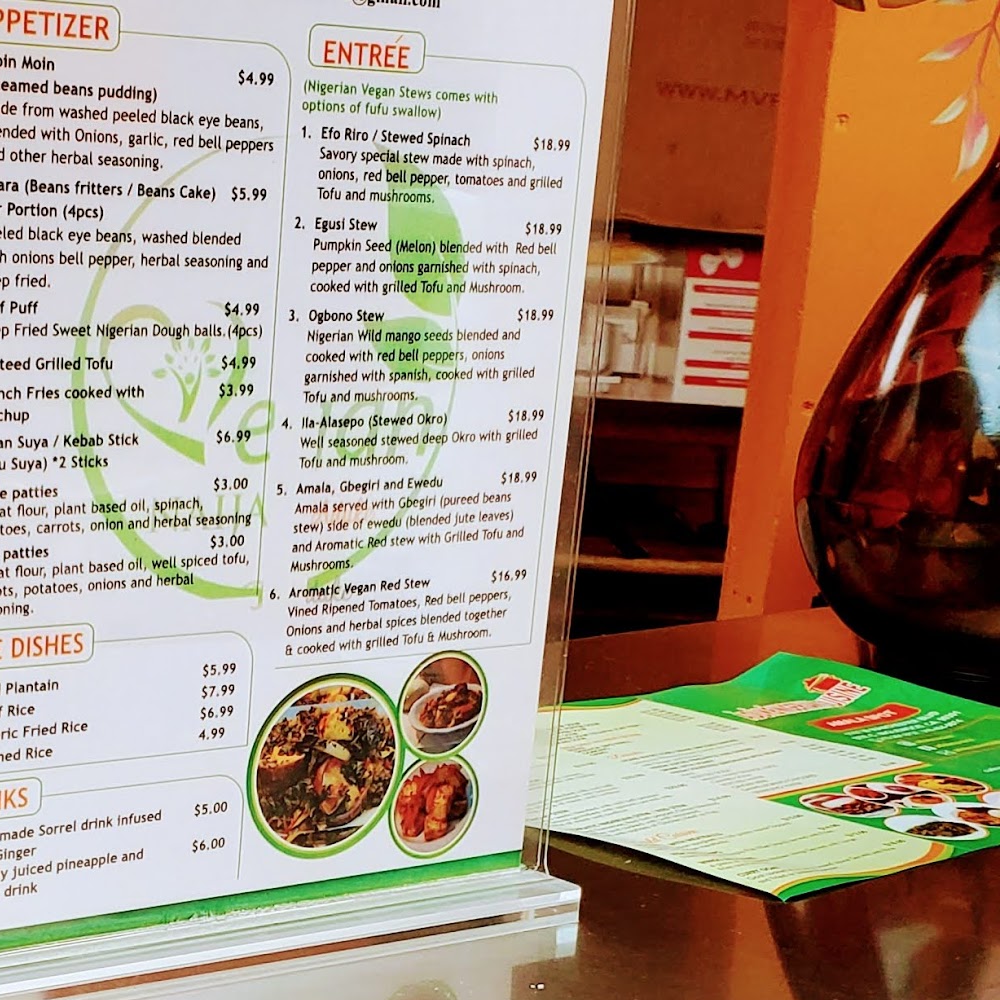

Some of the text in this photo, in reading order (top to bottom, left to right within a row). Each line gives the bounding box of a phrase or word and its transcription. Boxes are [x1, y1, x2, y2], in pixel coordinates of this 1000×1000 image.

[323, 34, 411, 70] ENTRÉE
[22, 55, 55, 71] Moin
[238, 70, 275, 86] $4.99
[53, 81, 94, 97] beans
[98, 86, 158, 104] pudding)
[304, 79, 498, 104] (Nigerian Vegan Stews comes with
[302, 100, 443, 121] options of fufu swallow)
[301, 126, 471, 148] 1. Efo Riro / Stewed Spinach
[533, 137, 571, 152] $18.99
[24, 179, 70, 196] (Beans
[74, 181, 123, 197] fritters
[127, 183, 133, 198] /
[137, 184, 175, 200] Beans
[179, 185, 217, 203] Cake)
[231, 187, 268, 203] $5.99
[7, 202, 58, 218] Portion
[62, 204, 104, 222] (4pcs)
[295, 217, 378, 233] 2. Egusi Stew
[525, 222, 562, 236] $18.99
[9, 300, 39, 315] Puff
[224, 302, 260, 317] $4.99
[289, 309, 385, 324] 3. Ogbono Stew
[517, 309, 554, 323] $18.99
[35, 356, 81, 371] Grilled
[85, 356, 113, 371] Tofu
[221, 355, 257, 370] $4.99
[26, 385, 60, 400] Fries
[64, 385, 112, 399] cooked
[116, 384, 145, 399] with
[219, 383, 254, 398] $3.99
[282, 412, 448, 430] 4. Ila-Alasepo (Stewed Okro)
[507, 409, 545, 423] $18.99
[17, 436, 49, 451] Suya
[52, 435, 59, 449] /
[63, 434, 104, 448] Kebab
[108, 433, 139, 447] Stick
[216, 430, 251, 444] $6.99
[11, 457, 48, 473] Suya)
[71, 455, 108, 469] Sticks
[213, 478, 249, 492] $3.00
[276, 476, 444, 496] 5. Amala, Gbegiri and Ewedu
[500, 471, 538, 486] $18.99
[12, 486, 58, 501] patties
[210, 535, 245, 550] $3.00
[3, 546, 49, 561] patties
[491, 569, 527, 584] $16.99
[269, 576, 431, 600] 6. Aromatic Vegan Red Stew
[11, 632, 84, 658] DISHES
[202, 662, 237, 678] $5.99
[5, 679, 60, 695] Plantain
[201, 684, 235, 700] $7.99
[7, 704, 35, 718] Rice
[200, 705, 234, 720] $6.99
[22, 723, 57, 738] Fried
[61, 720, 88, 735] Rice
[198, 727, 226, 741] 4.99
[25, 746, 53, 760] Rice
[194, 801, 229, 817] $5.00
[192, 837, 226, 853] $6.00
